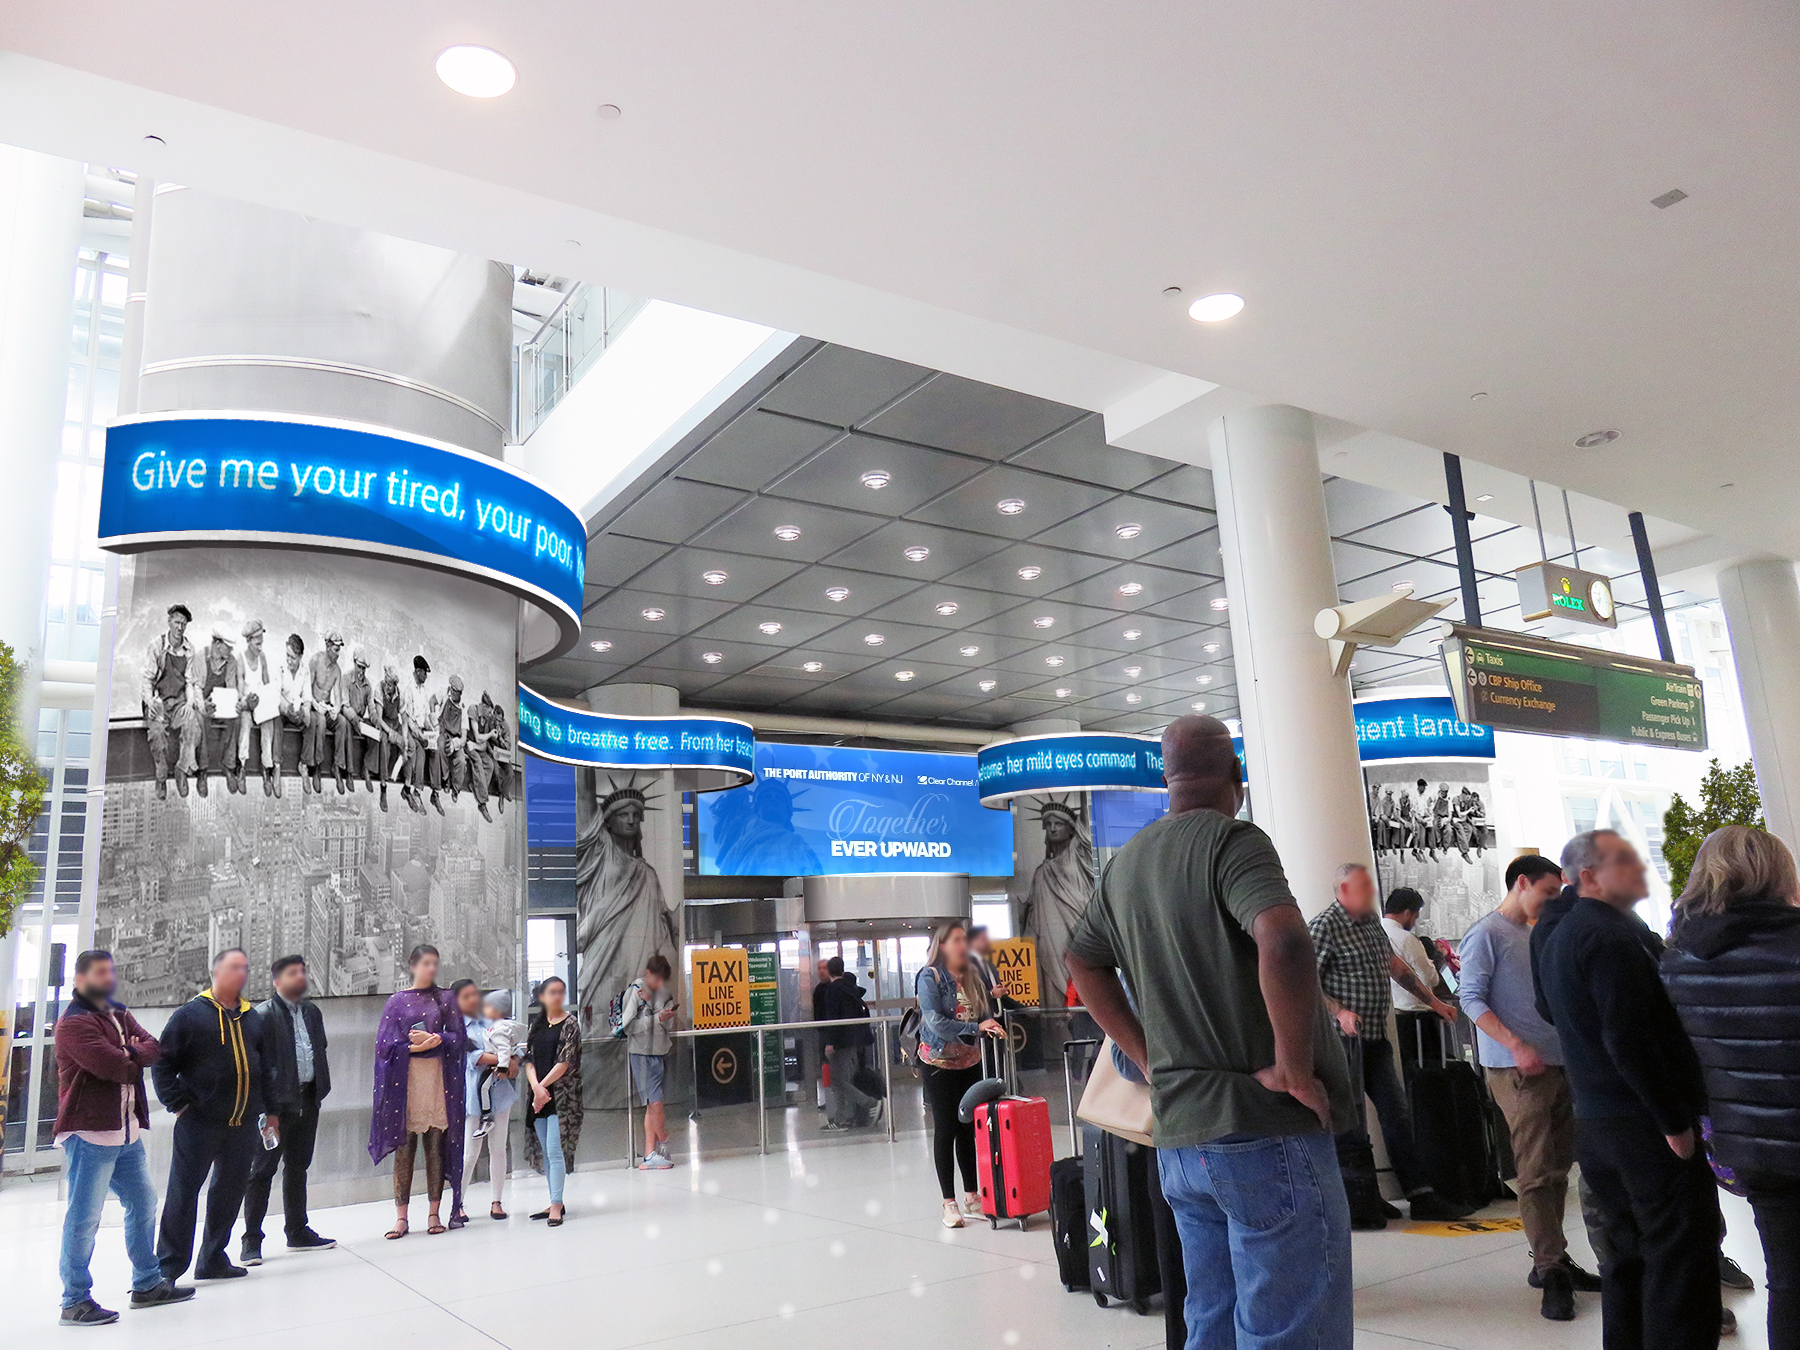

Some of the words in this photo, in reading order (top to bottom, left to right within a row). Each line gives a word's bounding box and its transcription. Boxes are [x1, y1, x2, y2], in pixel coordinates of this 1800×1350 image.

[131, 451, 207, 491] Give
[219, 457, 279, 490] me
[291, 462, 377, 498] your
[387, 469, 466, 522] tired,
[476, 497, 534, 543] your
[1552, 593, 1585, 611] ROLEX
[1485, 653, 1504, 666] Taxis
[1488, 675, 1502, 687] CBP
[1503, 676, 1520, 691] Ship
[1520, 679, 1543, 692] Office
[1665, 682, 1687, 694] AirTrain
[1490, 692, 1521, 709] Currency
[1523, 696, 1556, 713] Exchange
[1650, 695, 1667, 707] Green
[1668, 698, 1689, 712] Parking
[1642, 711, 1670, 725] Passenger
[545, 720, 561, 741] to
[568, 724, 629, 750] breathe
[634, 731, 674, 751] free.
[680, 732, 713, 750] From
[716, 733, 734, 753] her
[1631, 726, 1649, 737] Public
[1006, 755, 1024, 774] her
[1027, 751, 1053, 771] mild
[1056, 752, 1084, 770] eyes
[1086, 751, 1137, 769] command
[763, 767, 782, 778] THE
[783, 769, 807, 780] PORT
[808, 770, 858, 782] AUTHORITY
[858, 772, 870, 783] OF
[871, 773, 884, 783] NY
[885, 774, 890, 784] &
[892, 774, 903, 784] NJ
[927, 776, 946, 785] Clear
[946, 777, 974, 787] Channel
[826, 793, 951, 846] Together
[831, 840, 878, 857] EVER
[880, 841, 952, 858] UPWARD
[995, 947, 1032, 968] AXI
[696, 961, 743, 984] TAXI
[708, 985, 735, 1000] LINE
[701, 1001, 742, 1018] INSIDE
